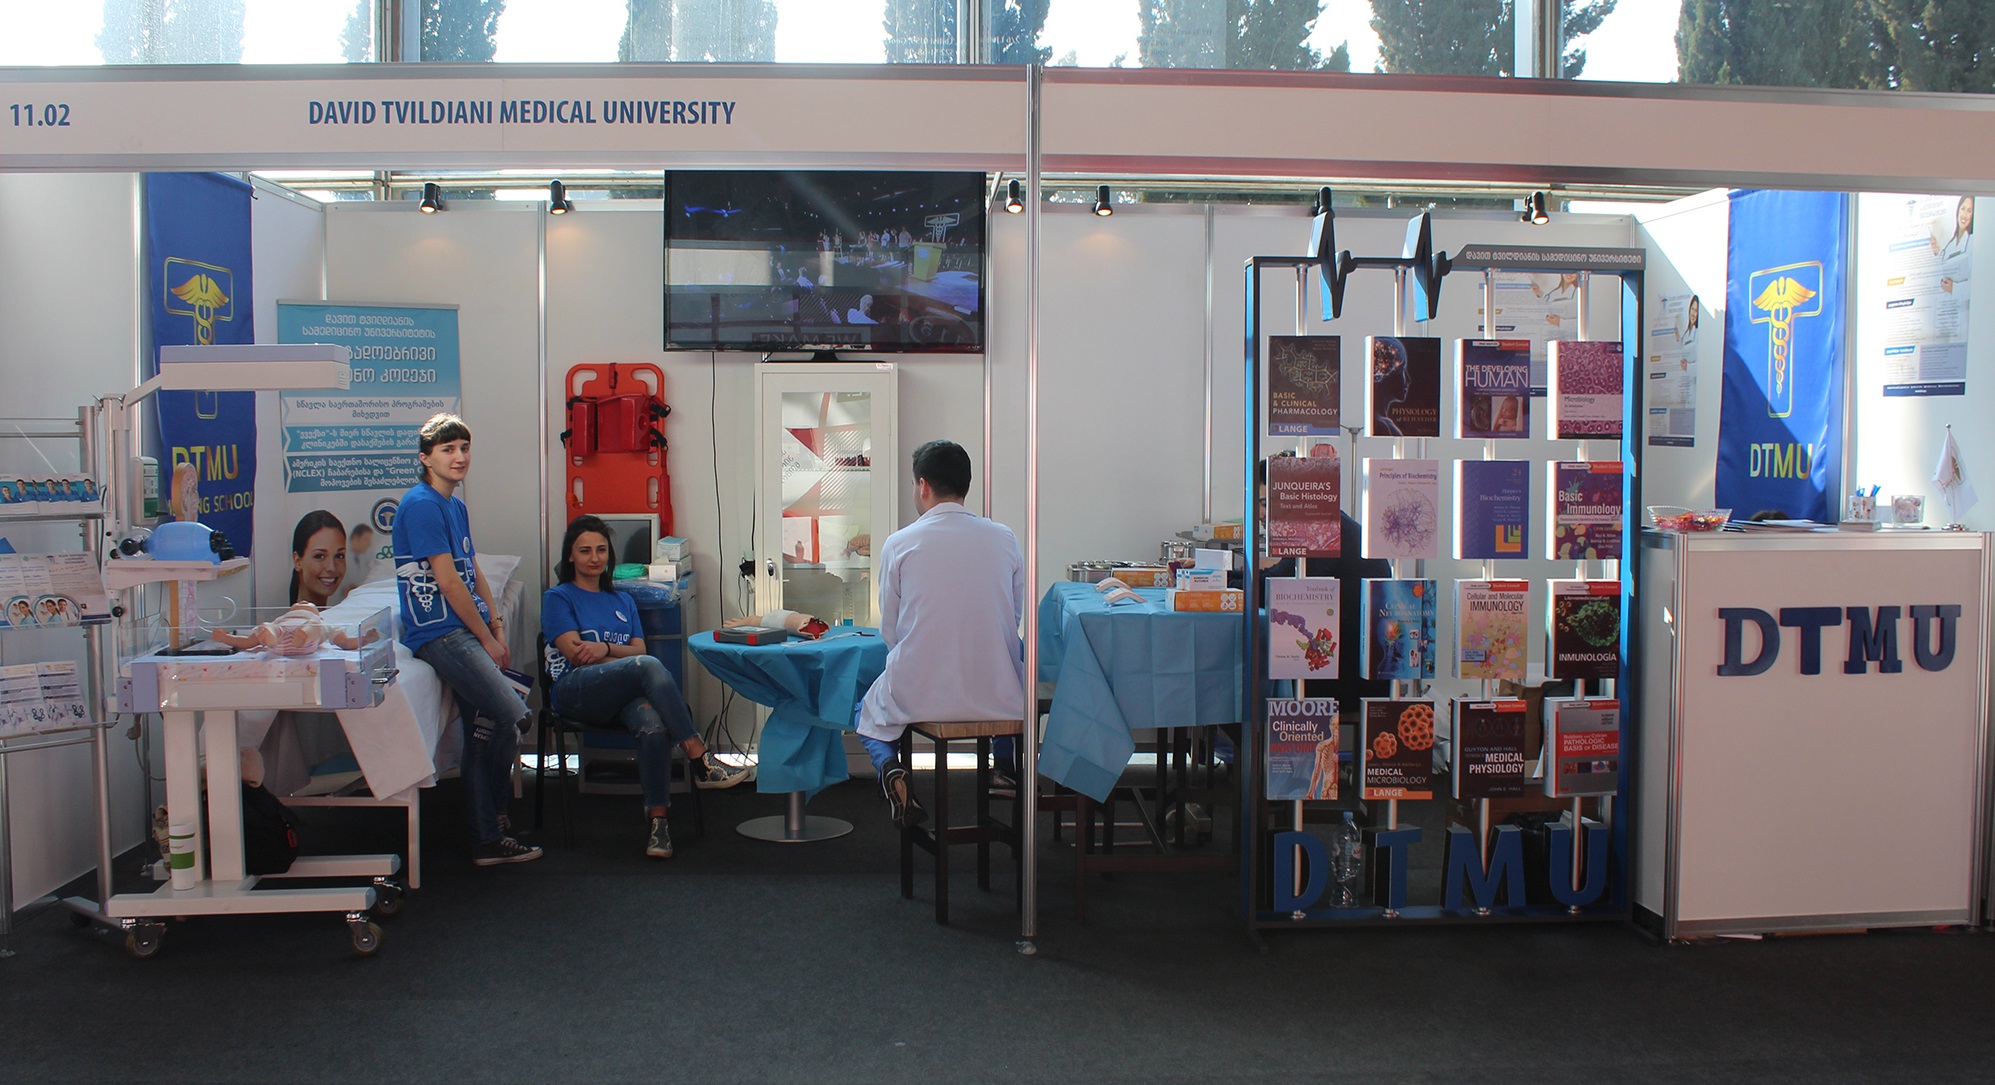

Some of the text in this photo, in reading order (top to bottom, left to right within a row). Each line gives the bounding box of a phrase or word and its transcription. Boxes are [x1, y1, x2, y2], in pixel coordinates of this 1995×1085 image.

[10, 103, 70, 127] 11.02
[308, 100, 736, 125] DAVID TVILDIANI MEDICAL UNIVERSITY
[1481, 365, 1528, 373] DEVELOPING
[1465, 371, 1529, 388] HUMAN
[1278, 425, 1308, 433] LANGE
[1749, 443, 1814, 480] DTMU
[1272, 482, 1331, 491] JUNQUEIRA'S
[1301, 492, 1338, 502] Histology
[1558, 490, 1583, 502] Basic
[1566, 503, 1621, 516] Immunology
[1275, 593, 1334, 601] BIOCHEMISTRY
[1466, 592, 1487, 600] Cellular
[1488, 592, 1498, 600] and
[1470, 600, 1524, 611] IMMUNOLOGY
[1716, 604, 1962, 677] DTMU
[1268, 700, 1339, 716] MOORE
[1272, 720, 1318, 733] Clinically
[1279, 731, 1324, 742] Oriented
[1563, 738, 1605, 746] PATHOLOGIC
[1485, 753, 1524, 763] MEDICAL
[1367, 768, 1403, 776] MEDICAL
[1469, 764, 1524, 774] PHYSIOLOGY
[1366, 776, 1427, 784] MICROBIOLOGY
